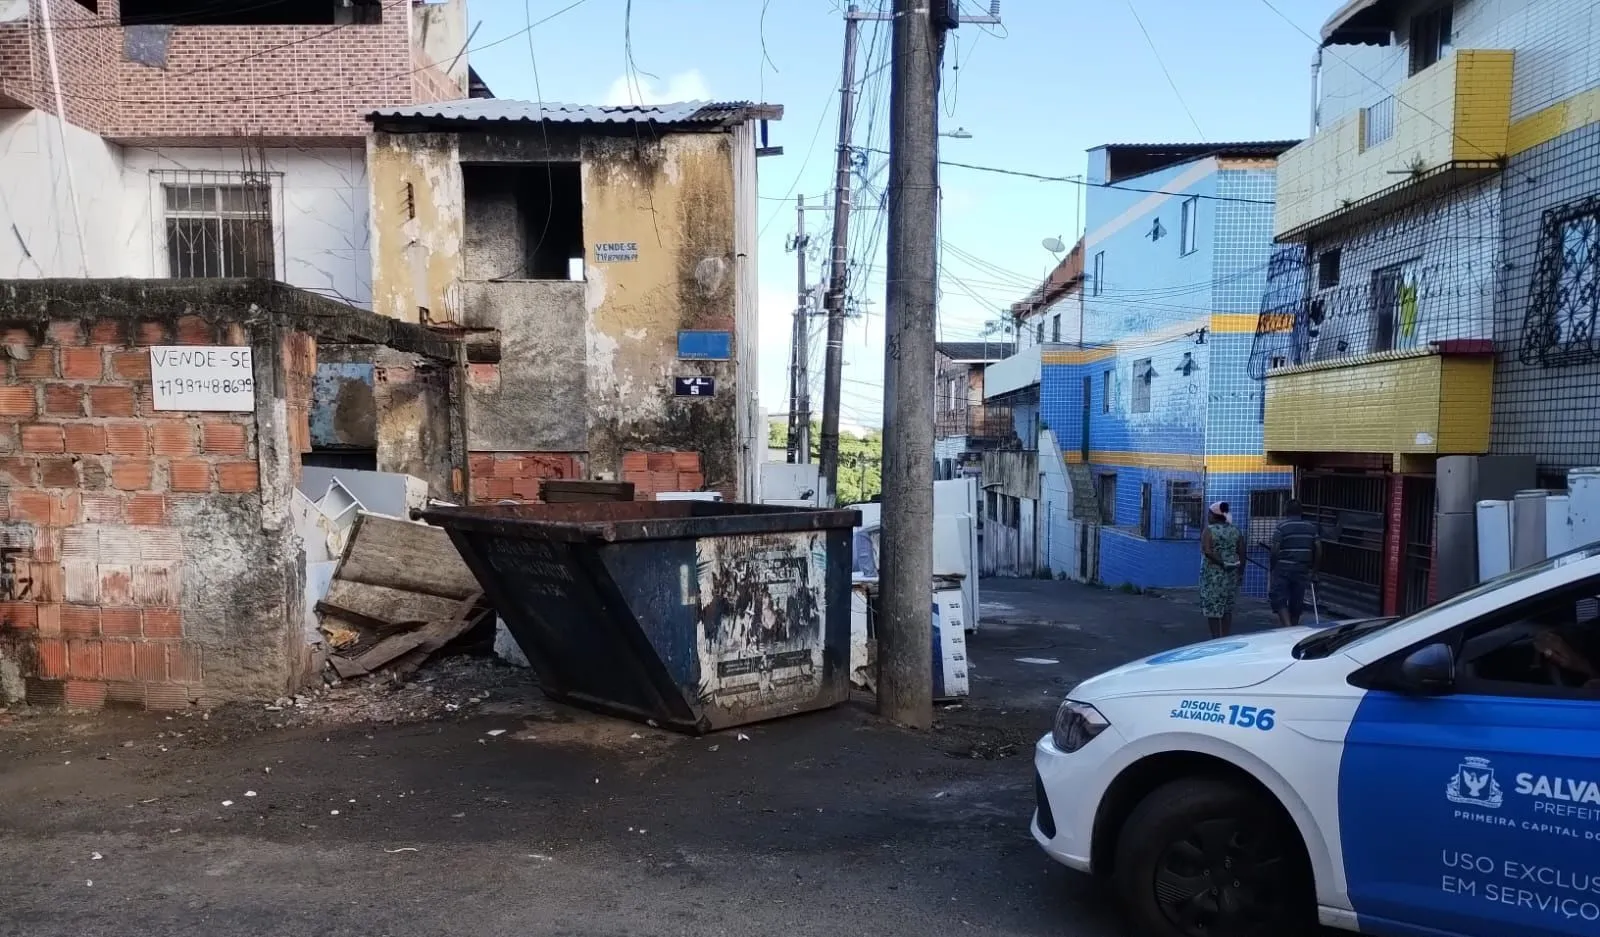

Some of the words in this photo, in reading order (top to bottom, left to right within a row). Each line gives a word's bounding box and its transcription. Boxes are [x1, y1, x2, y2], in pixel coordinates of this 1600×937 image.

[152, 350, 250, 368] VENDE-SE
[1170, 709, 1226, 724] SALVADOR
[1181, 700, 1222, 712] DISQUE
[1228, 704, 1276, 731] 156
[1514, 772, 1600, 805] SALVA
[1454, 810, 1516, 827] PRIMEIRA
[1521, 820, 1579, 838] CAPITAL
[1534, 801, 1600, 821] PREFEIT
[1442, 849, 1494, 873] USO
[1504, 860, 1600, 894] EXCLUS
[1442, 875, 1476, 897] EM
[1485, 884, 1600, 920] SERVIÇO
